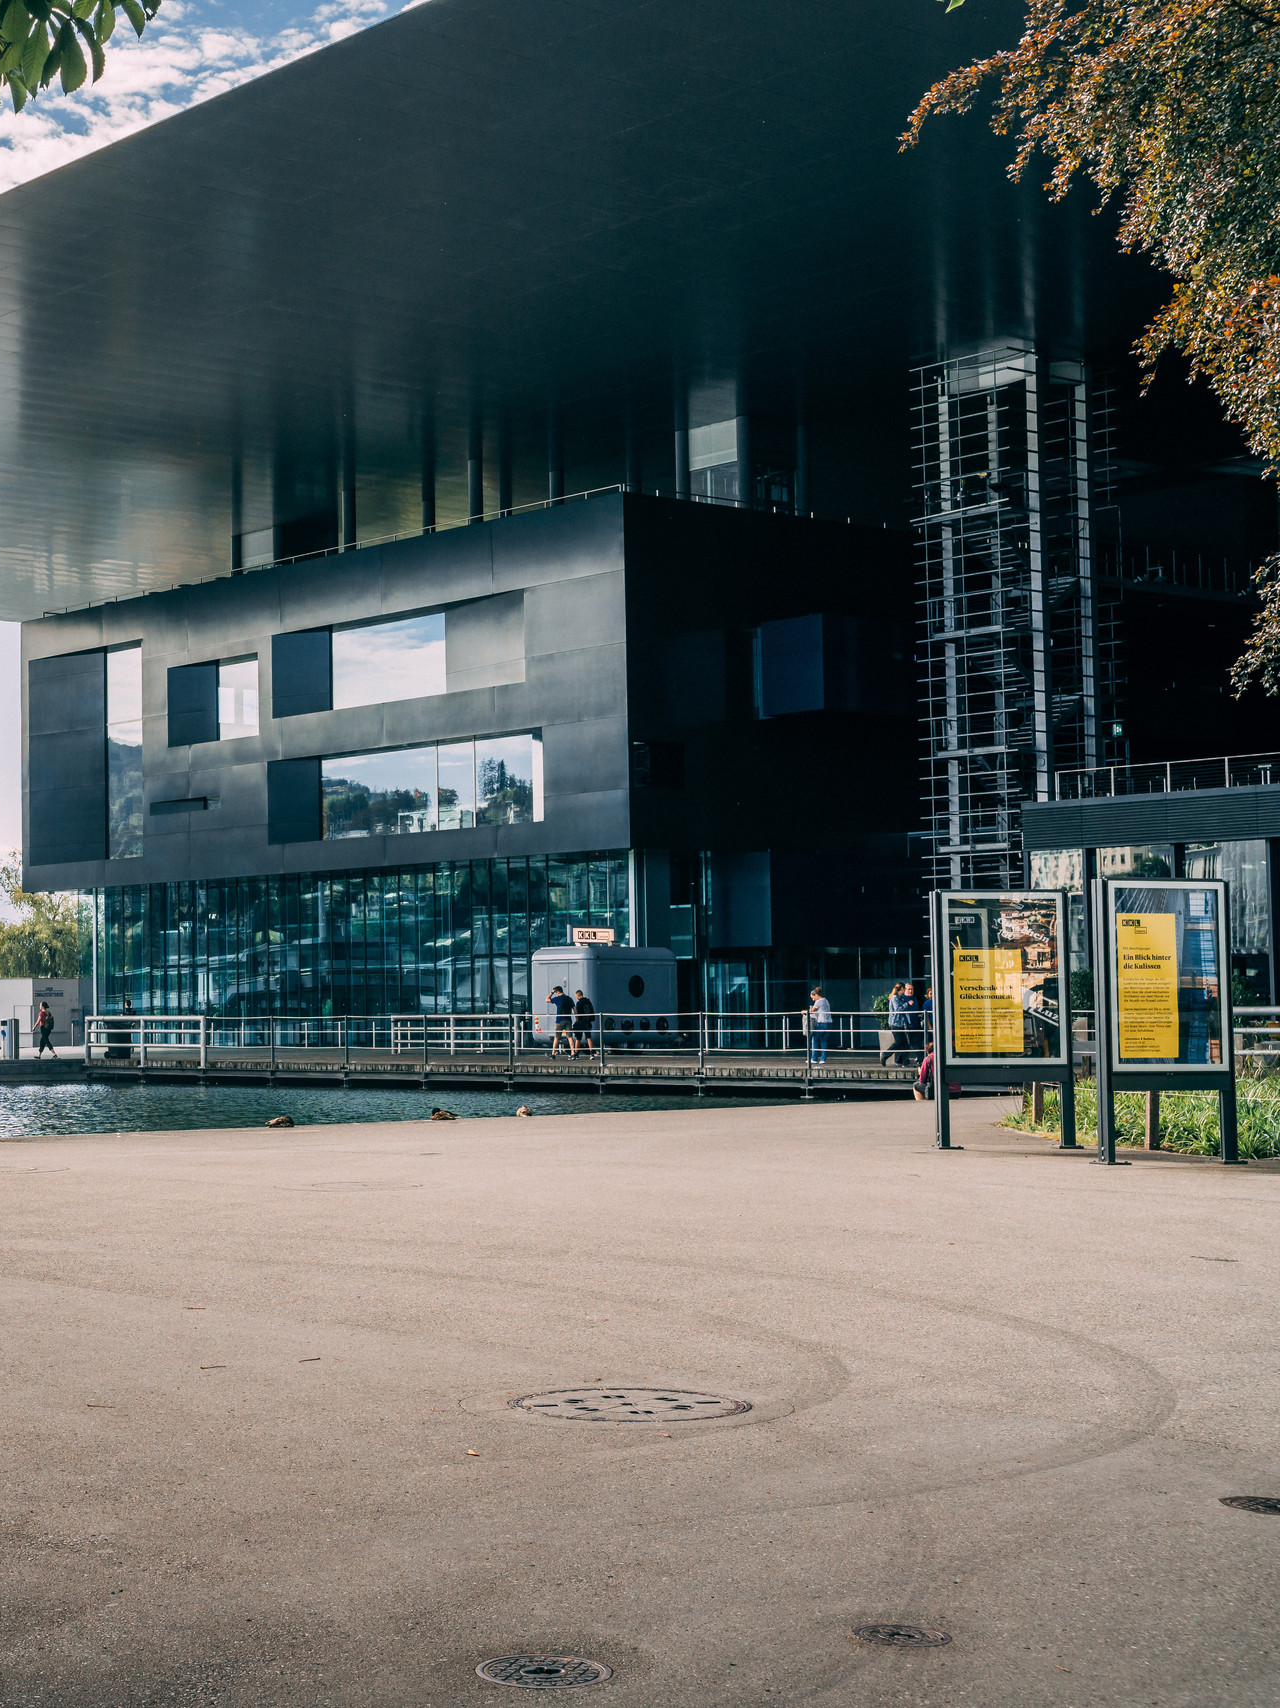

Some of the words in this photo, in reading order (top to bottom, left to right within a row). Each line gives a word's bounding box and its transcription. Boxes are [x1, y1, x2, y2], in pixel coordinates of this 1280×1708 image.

[578, 931, 596, 939] KKL
[1135, 953, 1151, 961] Blick
[1152, 953, 1171, 961] hinter
